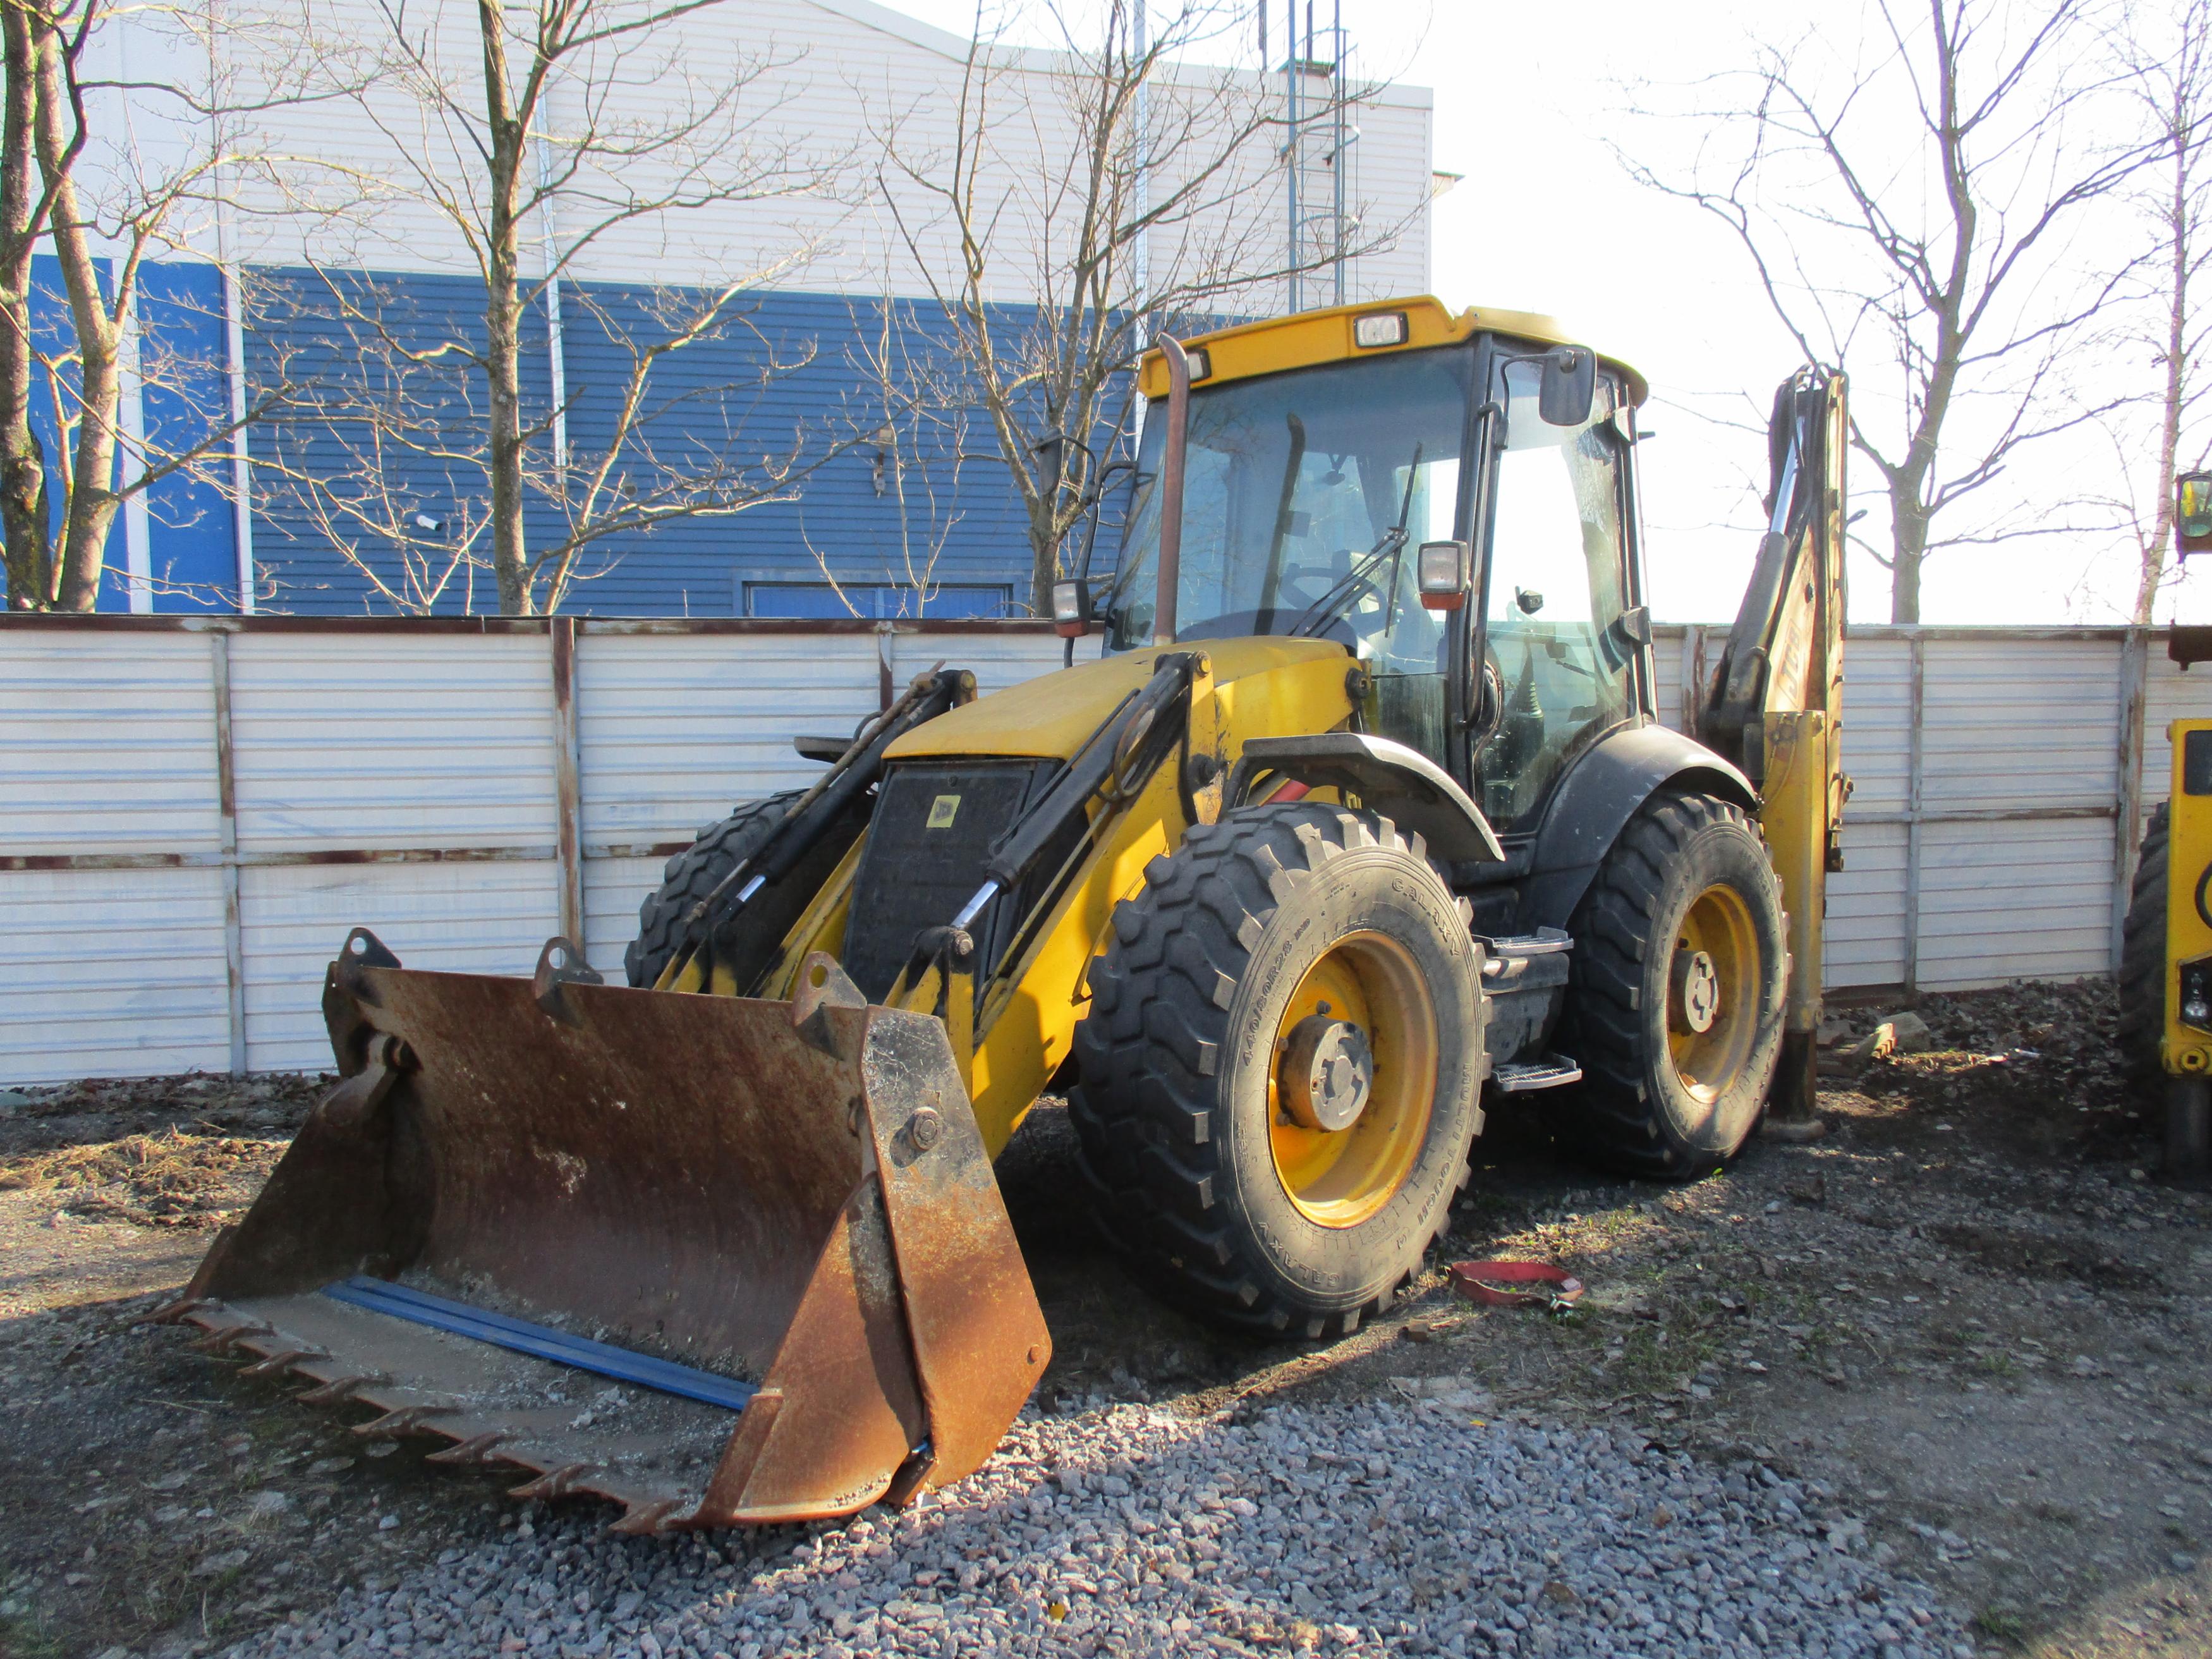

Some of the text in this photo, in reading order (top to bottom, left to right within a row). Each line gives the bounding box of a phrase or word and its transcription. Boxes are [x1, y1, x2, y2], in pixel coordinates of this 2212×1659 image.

[1780, 626, 1801, 700] JCB
[1392, 877, 1460, 956] GALAXY
[1243, 940, 1292, 1066] 440/80R28
[1417, 1063, 1472, 1226] MULTI TOUGH
[1258, 1221, 1340, 1287] GALAXY
